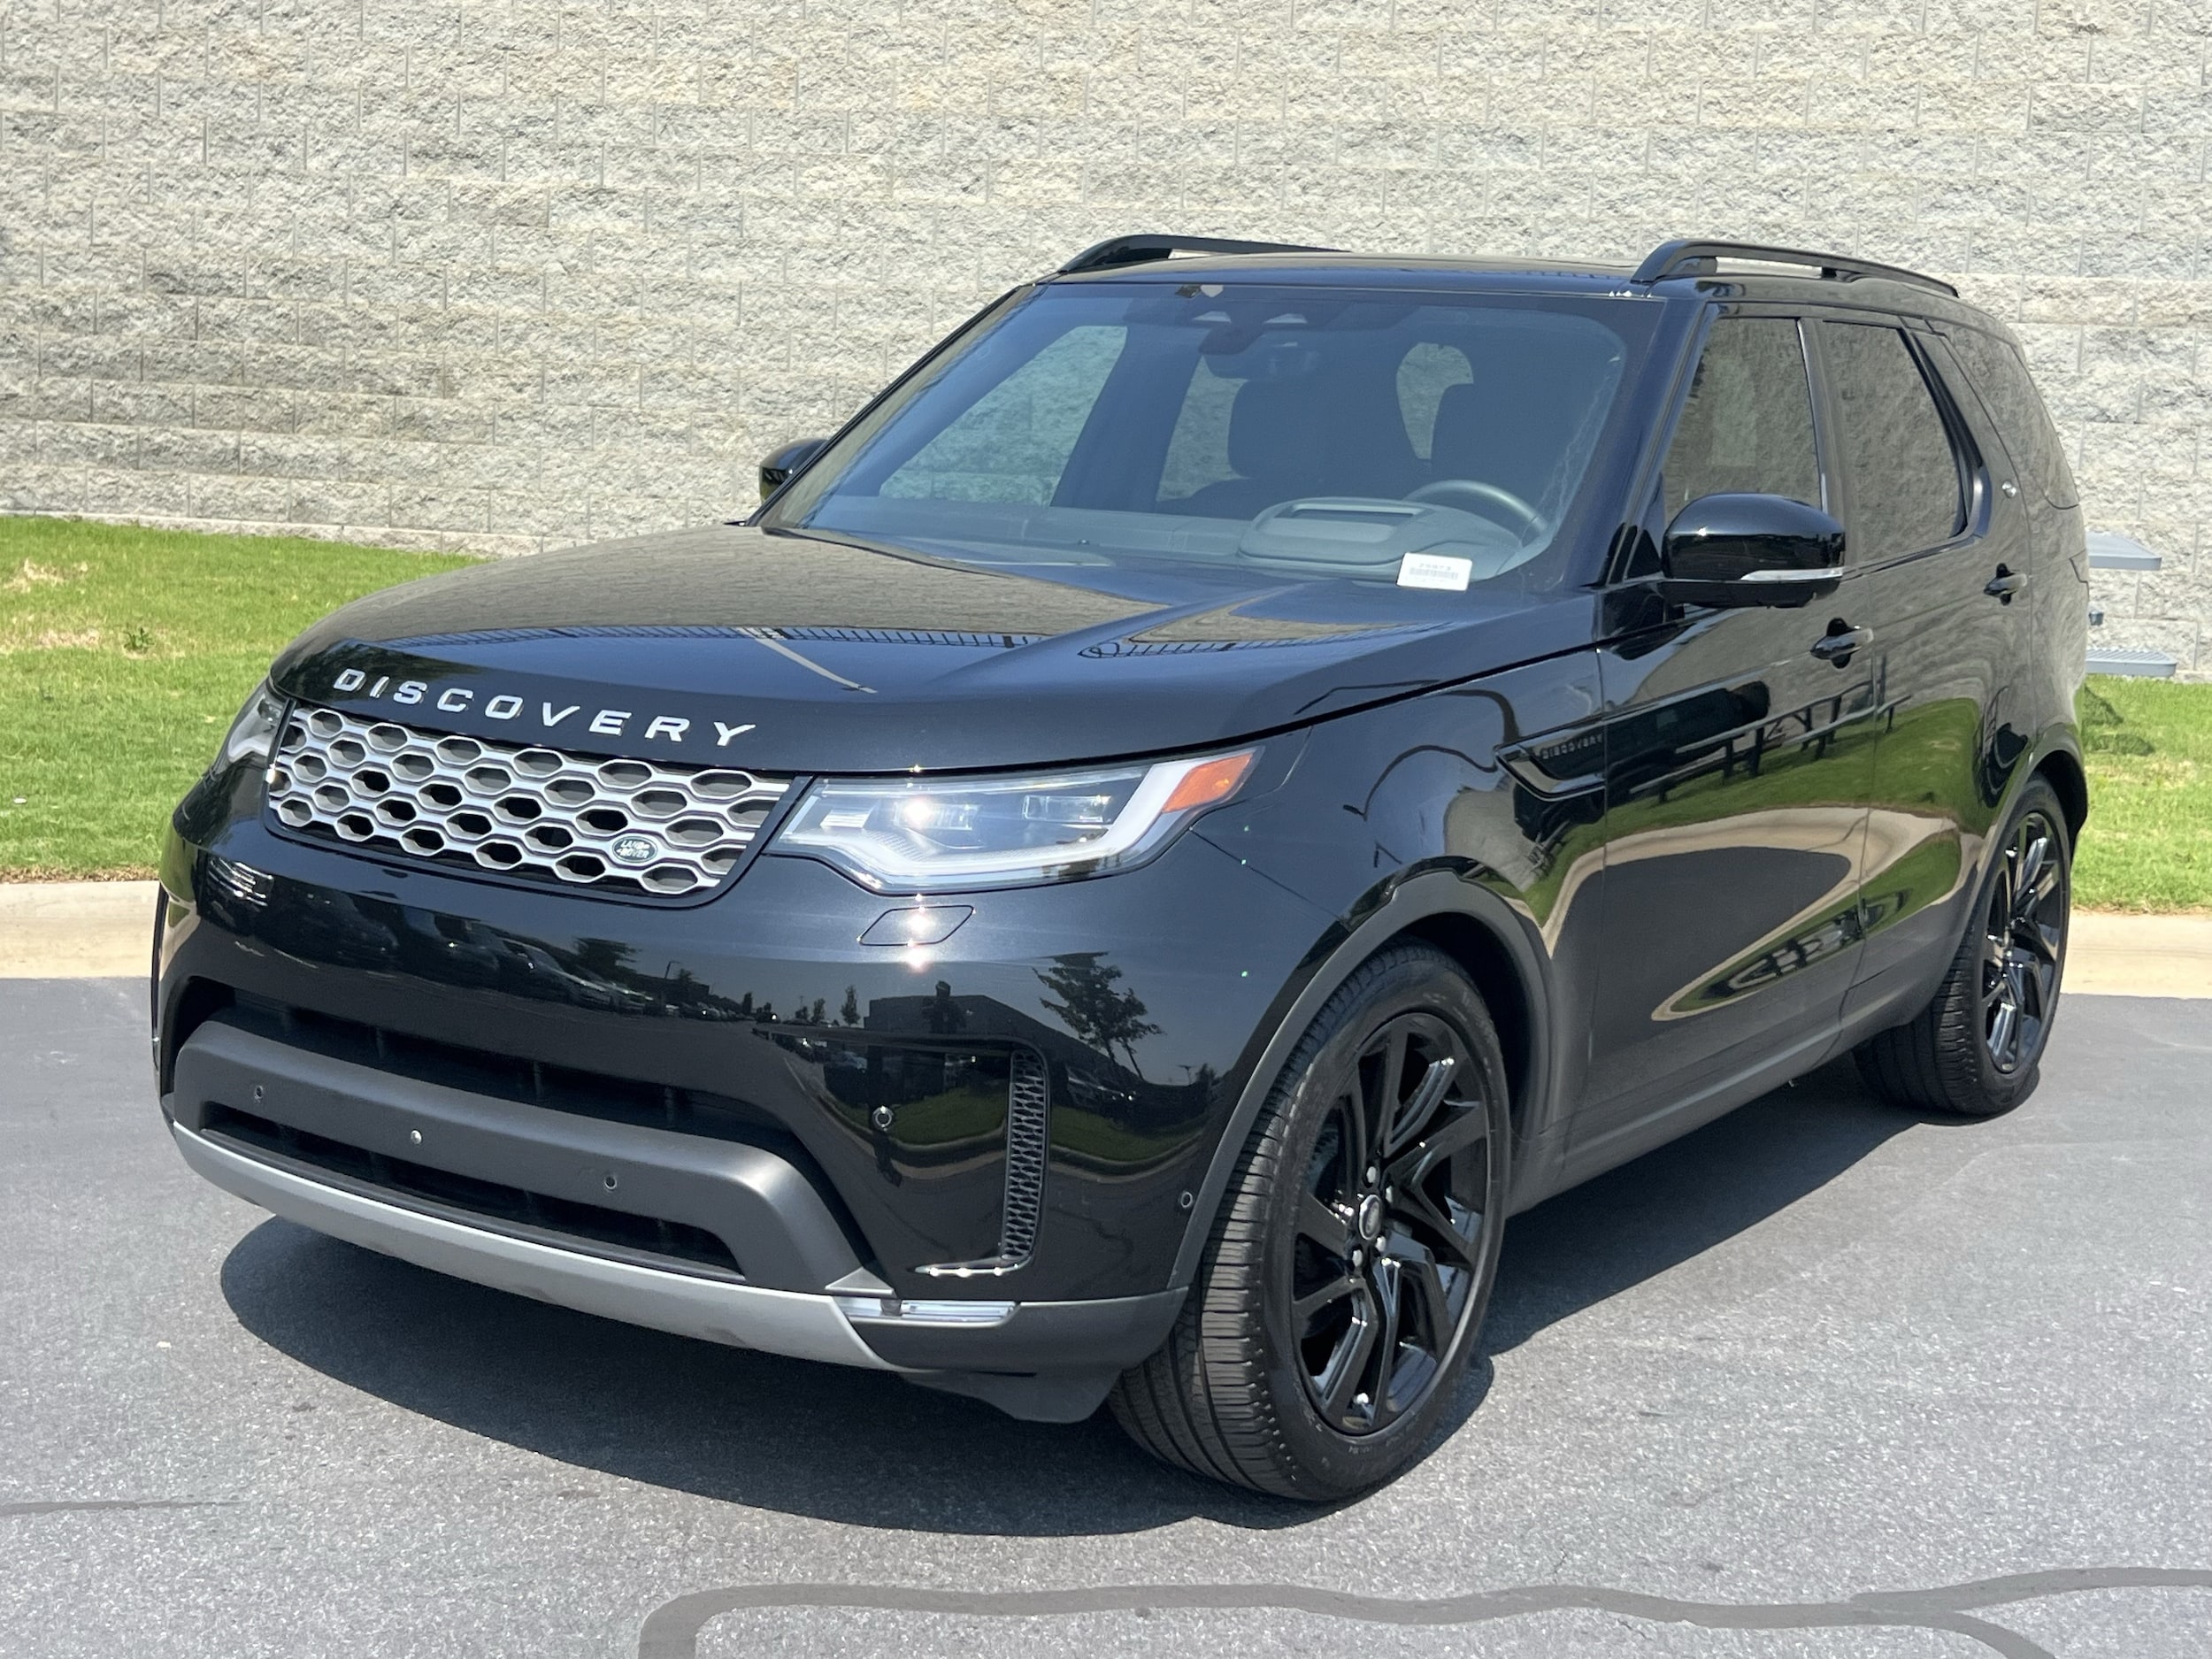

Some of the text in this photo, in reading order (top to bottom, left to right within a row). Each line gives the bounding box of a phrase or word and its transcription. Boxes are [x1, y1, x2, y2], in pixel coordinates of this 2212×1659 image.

[334, 668, 757, 747] DISCOVERY
[1542, 733, 1602, 759] DISCOVERY
[620, 840, 645, 849] LAND
[619, 849, 649, 858] ROVER
